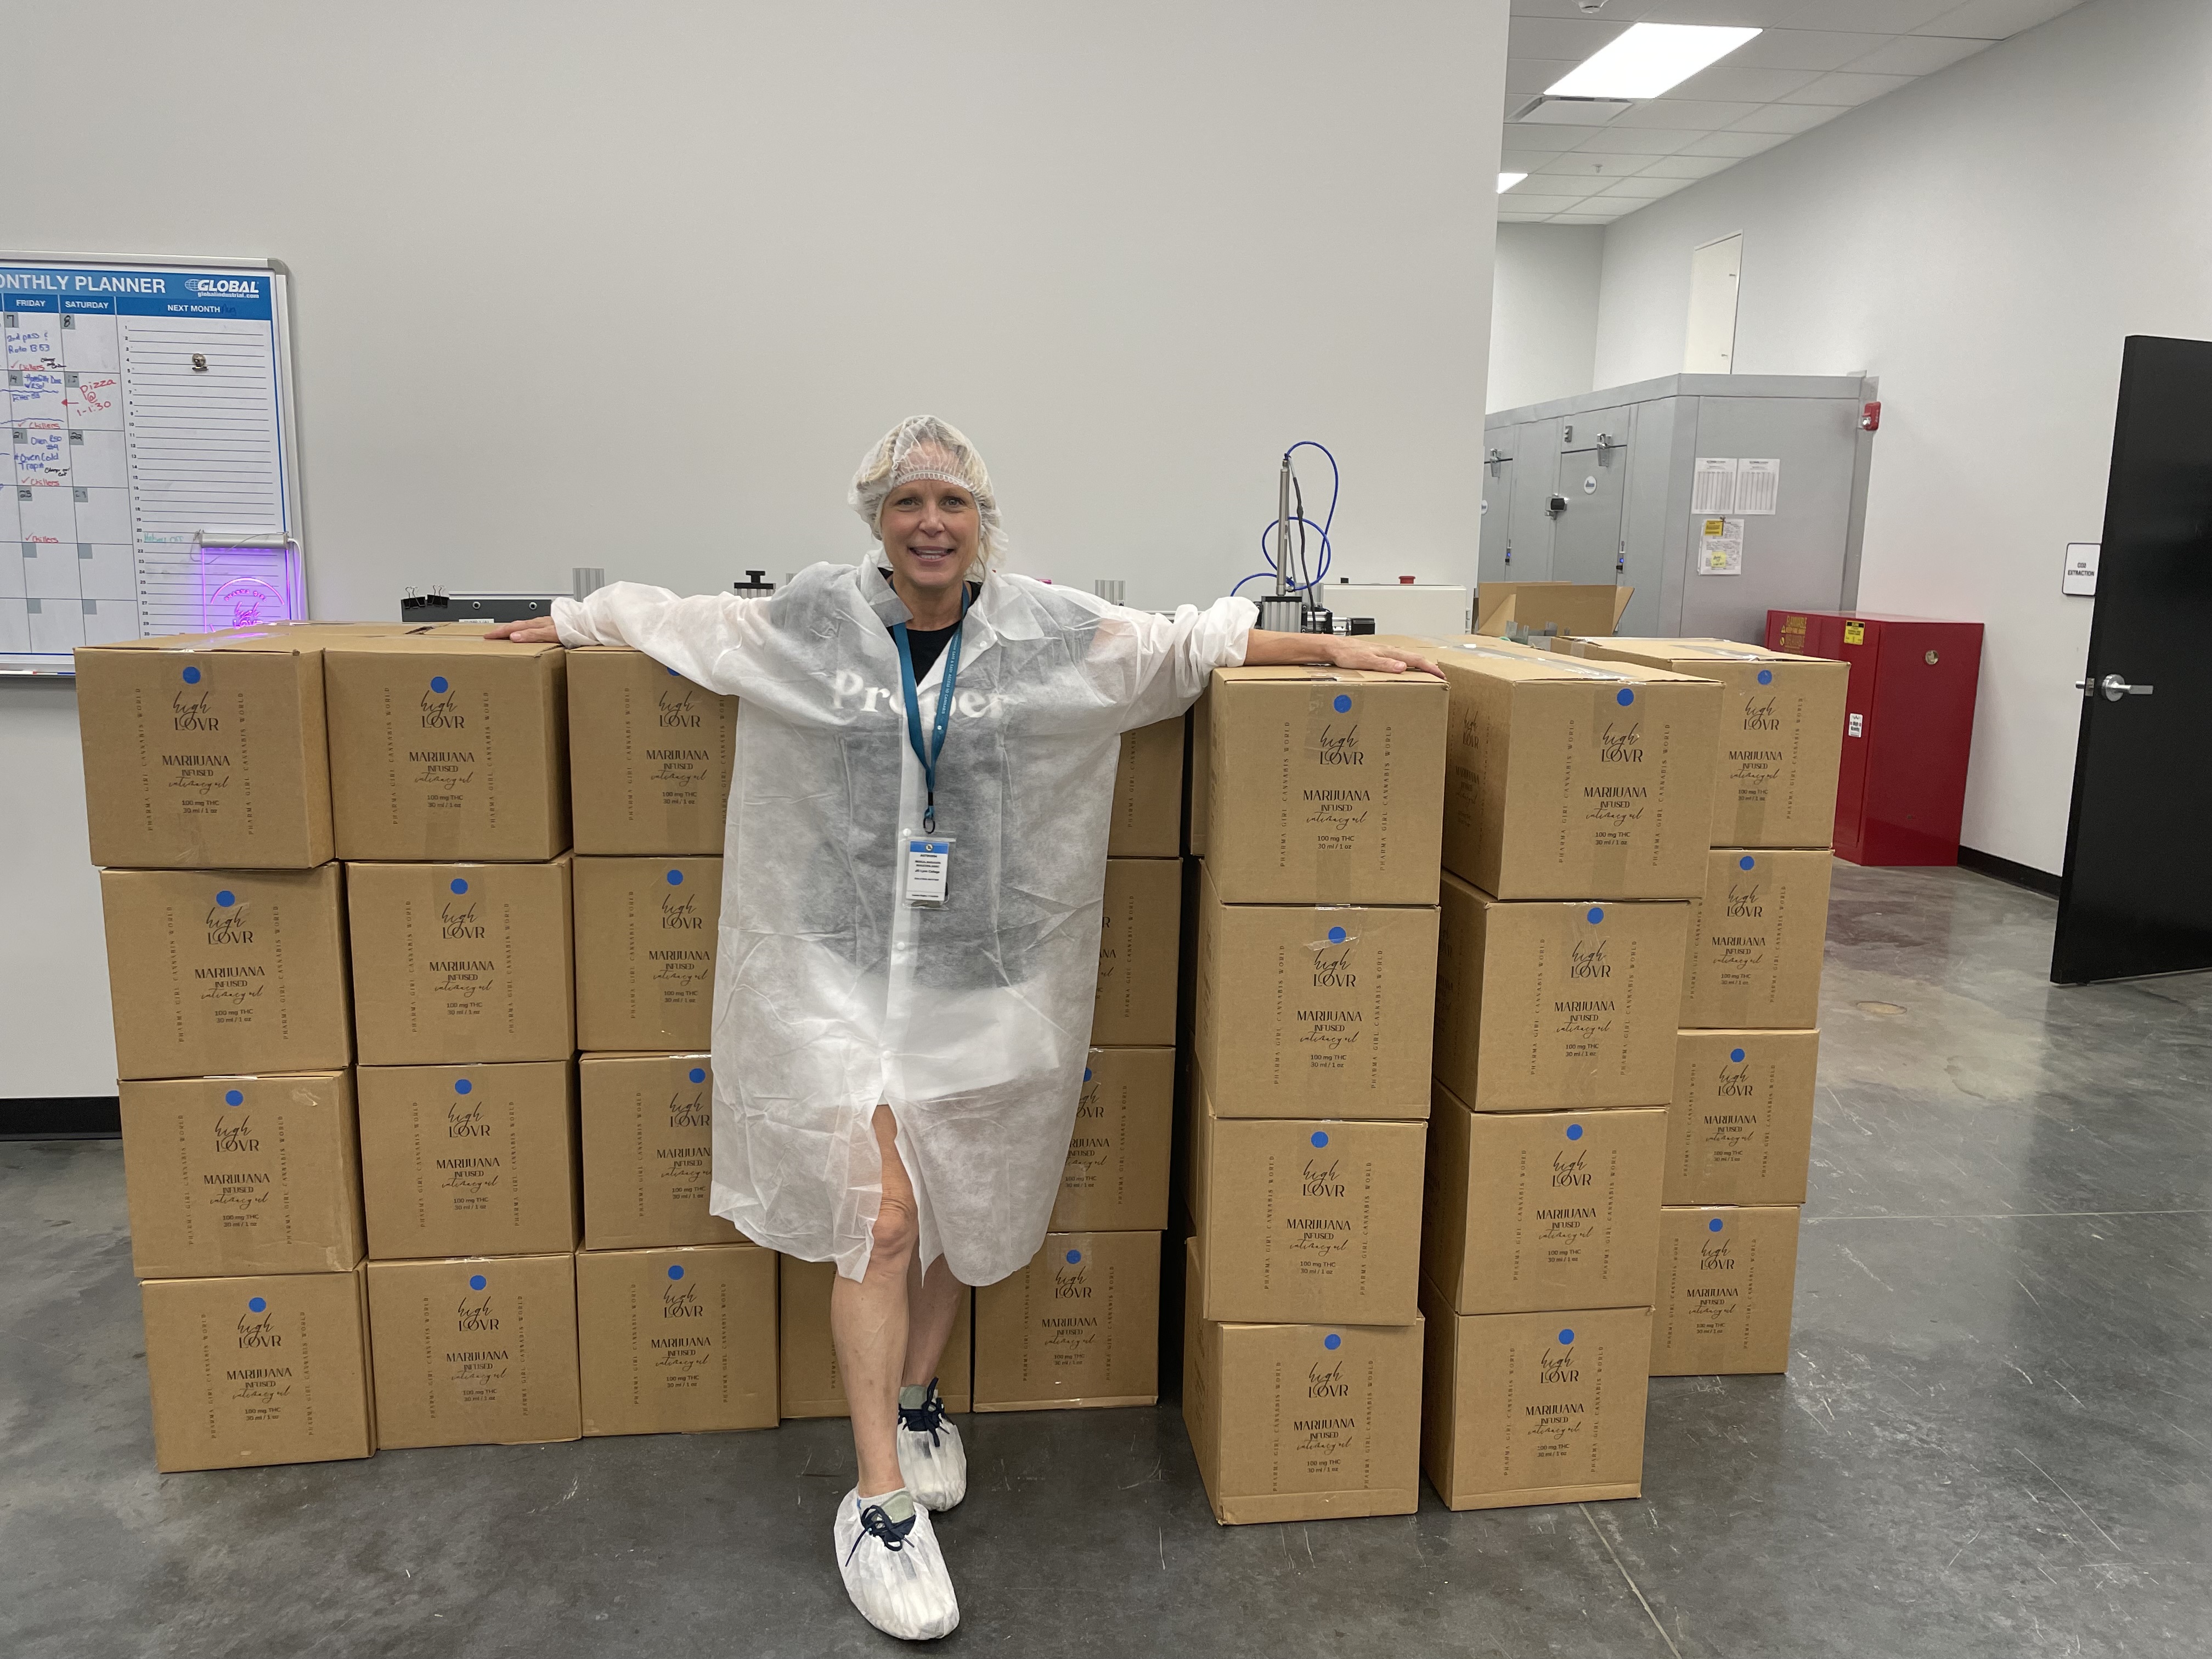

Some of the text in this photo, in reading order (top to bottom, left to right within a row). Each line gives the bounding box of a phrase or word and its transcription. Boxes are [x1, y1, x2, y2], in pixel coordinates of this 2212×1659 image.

[75, 276, 166, 293] PLANNER
[198, 280, 259, 293] GLOBAL
[7, 314, 14, 328] 7
[64, 315, 71, 328] 8
[87, 391, 98, 404] @
[70, 432, 82, 441] 22
[224, 589, 250, 601] PHARMA
[162, 755, 230, 766] MARIJUANA
[409, 752, 475, 763] MARIJUANA
[646, 750, 709, 760] MARIJUANA
[1729, 751, 1782, 760] MARIJUANA
[1304, 790, 1370, 801] MARIJUANA
[1584, 787, 1647, 798] MARIJUANA
[1712, 937, 1766, 946] MARIJUANA
[648, 951, 710, 960] MARIJUANA
[429, 961, 494, 972] MARIJUANA
[194, 966, 265, 979] MARIJUANA
[215, 980, 248, 988] INFUSED
[1554, 1001, 1615, 1012] MARIJUANA
[1297, 1011, 1362, 1022] MARIJUANA
[1076, 1107, 1104, 1118] OVR
[1704, 1115, 1757, 1125] MARIJUANA
[1069, 1138, 1110, 1147] RIJUANA
[657, 1147, 712, 1158] MARIJUAN
[436, 1157, 500, 1170] MARIJUANA
[204, 1173, 270, 1185] MARIJUANA
[1536, 1207, 1596, 1220] MARIJUANA
[1287, 1219, 1351, 1231] MARIJUANA
[1687, 1288, 1738, 1297] MARIJUANA
[1042, 1317, 1097, 1328] MARIJUANA
[651, 1336, 711, 1348] MARIJUANA
[446, 1350, 509, 1363] MARIJUANA
[226, 1367, 292, 1380] MARIJUANA
[245, 1380, 276, 1389] INFUSED
[1525, 1403, 1584, 1417] MARIJUANA
[1294, 1418, 1355, 1431] MARIJUANA
